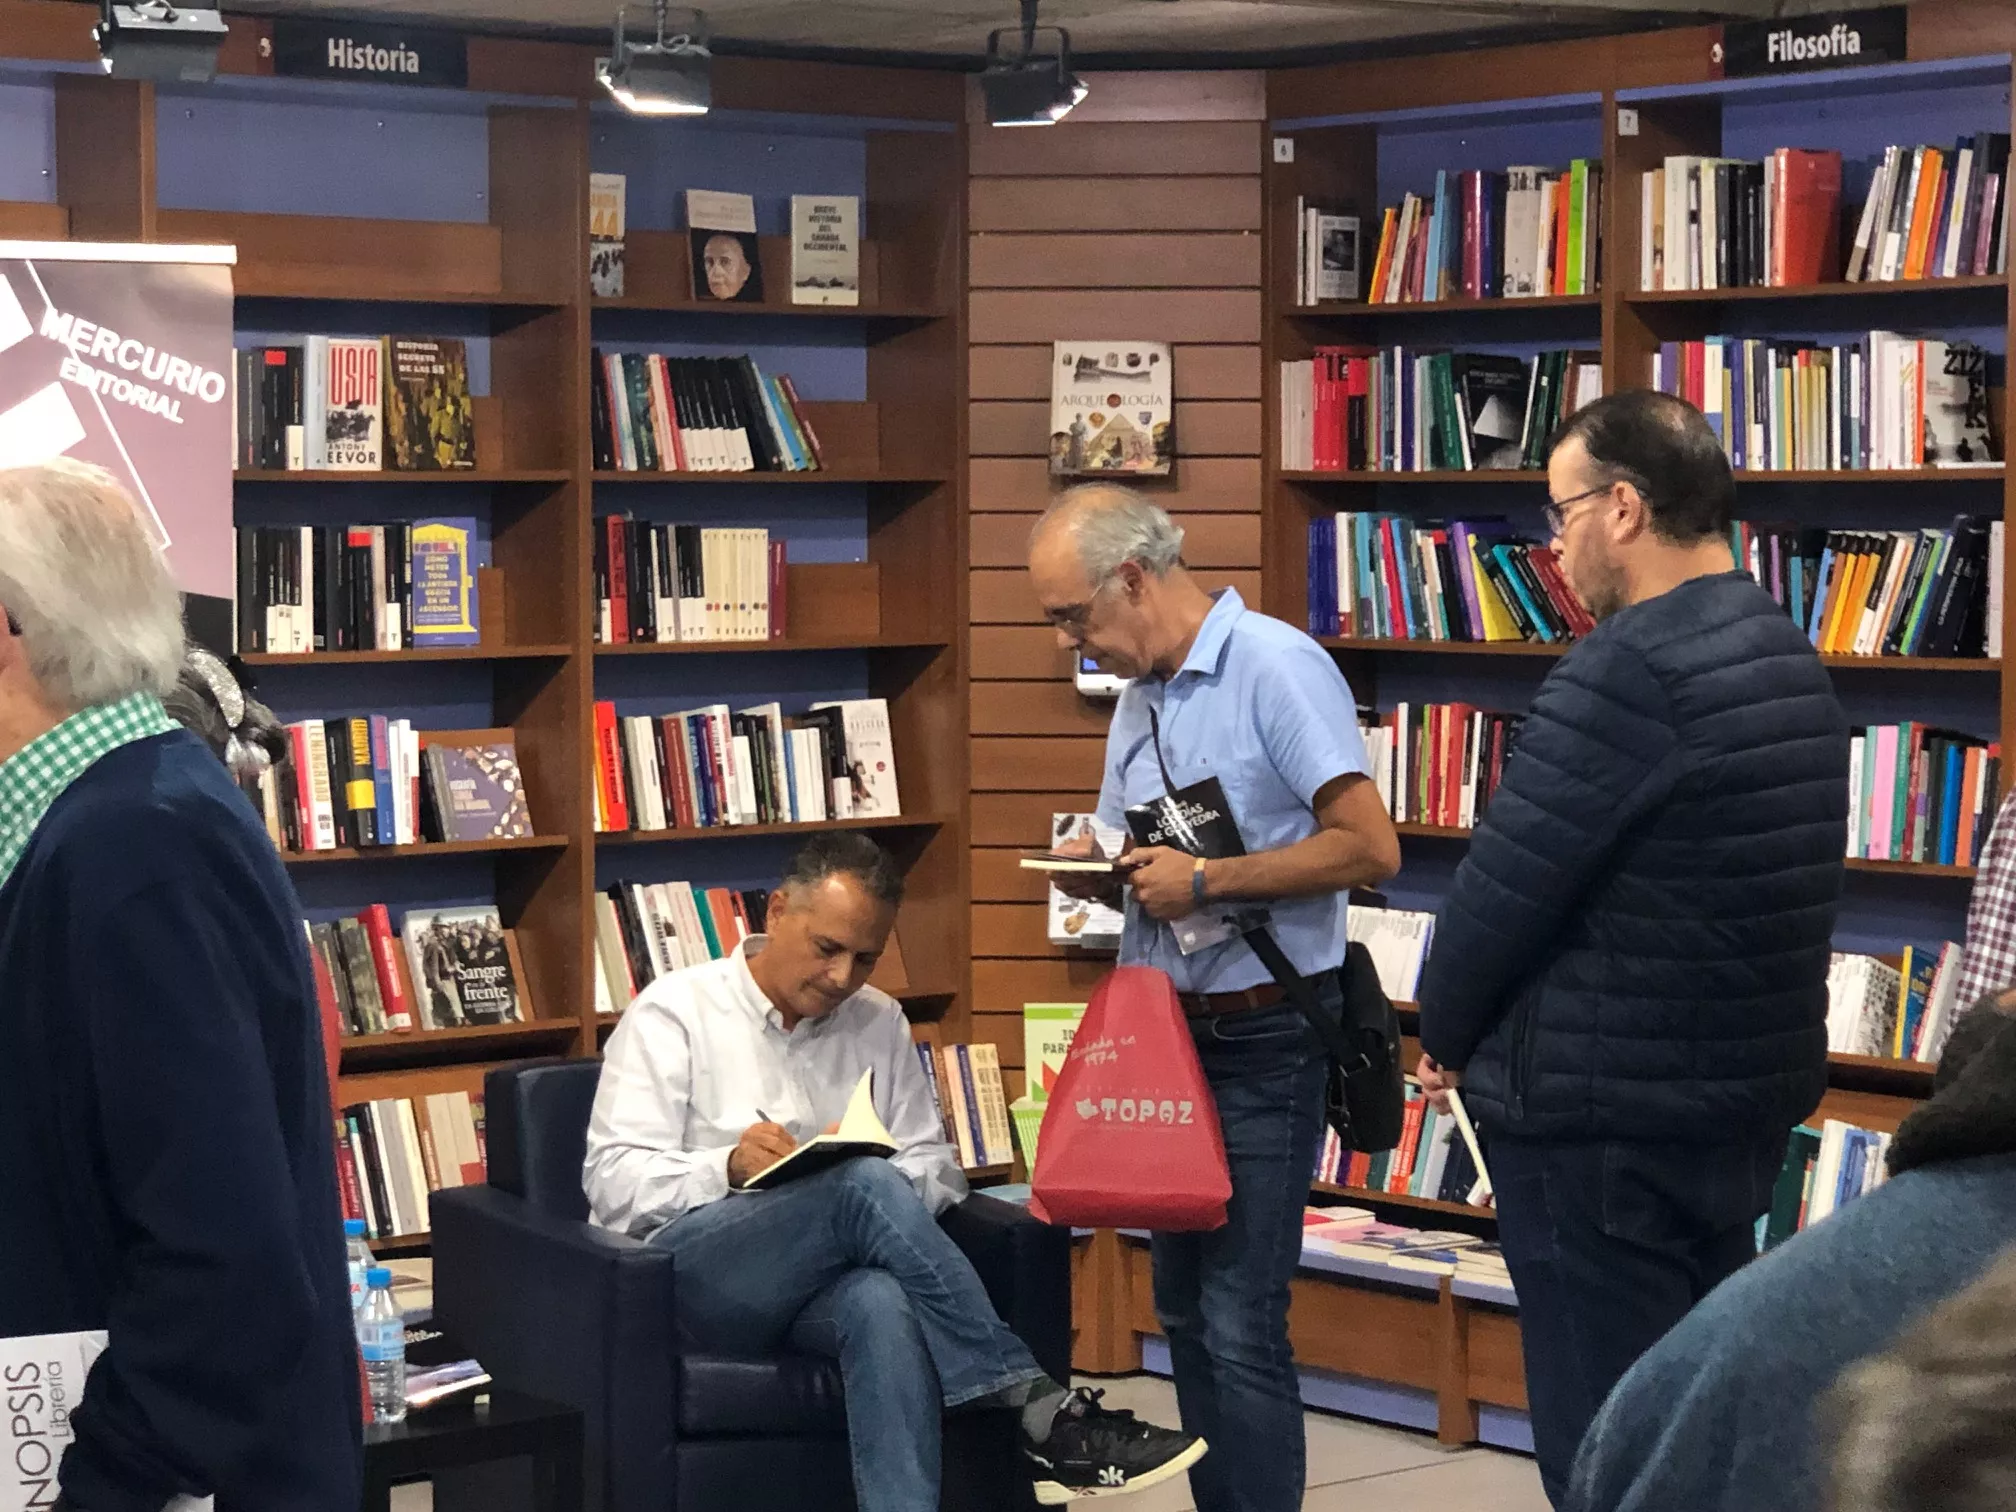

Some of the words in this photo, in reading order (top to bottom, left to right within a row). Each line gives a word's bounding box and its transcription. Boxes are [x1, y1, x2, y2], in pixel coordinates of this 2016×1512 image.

[327, 38, 420, 74] Historia
[1768, 24, 1861, 63] Filosofía
[40, 307, 226, 404] MERCURIO
[59, 356, 184, 424] EDITORIAL
[331, 347, 378, 407] USIA
[327, 451, 377, 465] EEVOR
[328, 443, 367, 452] ANTONY
[1148, 831, 1164, 844] DE
[1164, 809, 1221, 837] GYEDRA
[454, 962, 507, 984] Sangre
[464, 983, 508, 1001] frente
[1042, 1043, 1071, 1054] PAR
[1100, 1096, 1194, 1125] TOPAZ
[45, 1360, 71, 1439] Librería
[4, 1361, 56, 1512] NOPSIS
